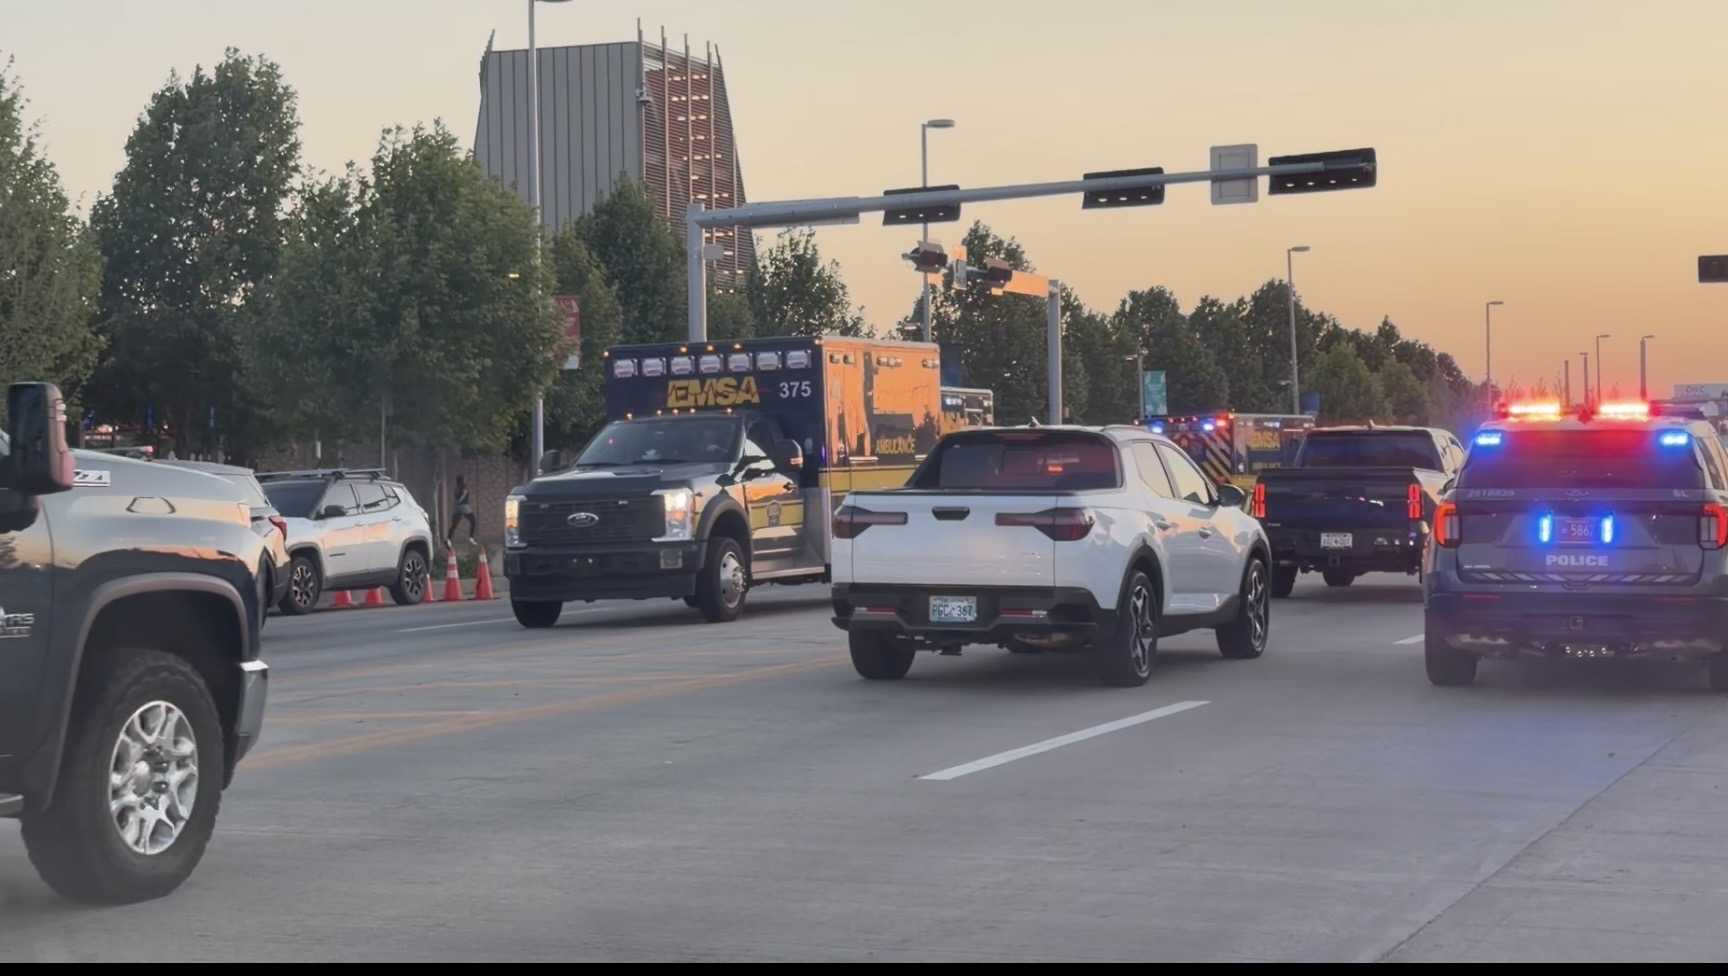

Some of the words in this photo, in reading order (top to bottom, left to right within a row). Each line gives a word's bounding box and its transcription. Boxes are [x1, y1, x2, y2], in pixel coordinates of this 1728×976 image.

[667, 376, 760, 408] EMSA
[778, 381, 812, 398] 375
[1545, 554, 1609, 567] POLICE
